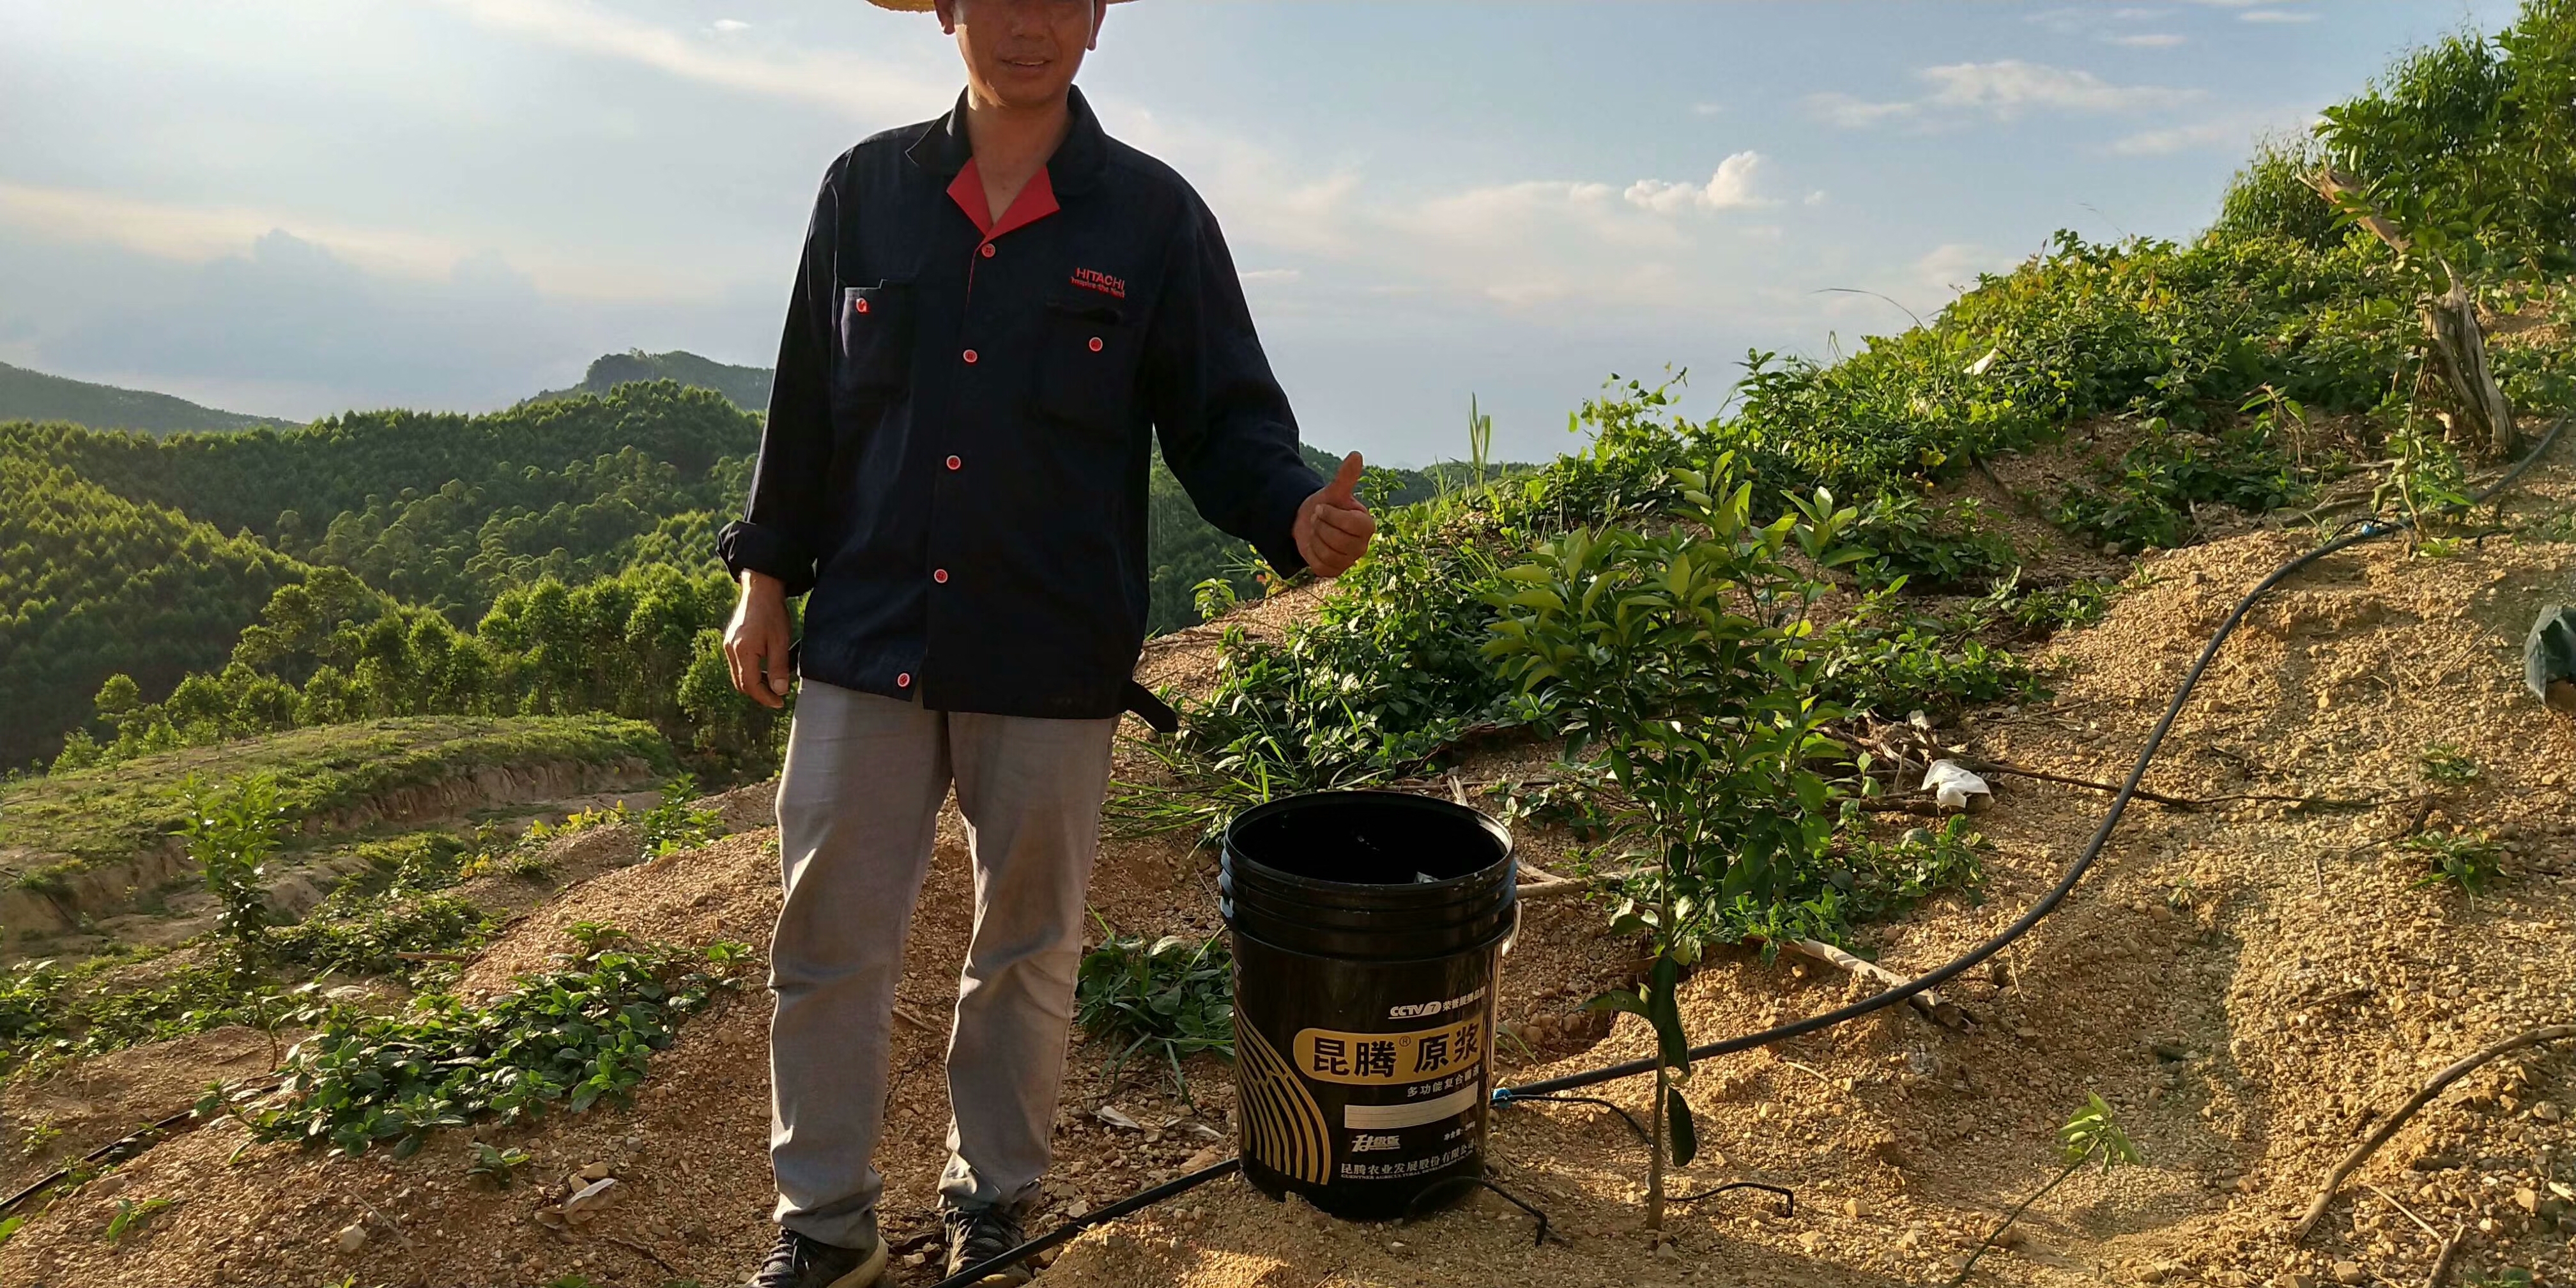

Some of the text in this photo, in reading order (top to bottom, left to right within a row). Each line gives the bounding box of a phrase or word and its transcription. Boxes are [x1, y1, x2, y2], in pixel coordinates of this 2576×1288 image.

[1070, 276, 1096, 289] Inspire
[1097, 284, 1109, 293] the
[1075, 267, 1124, 291] HITACHI
[1341, 1137, 1476, 1175] 昆腾农业发展股份有限公司
